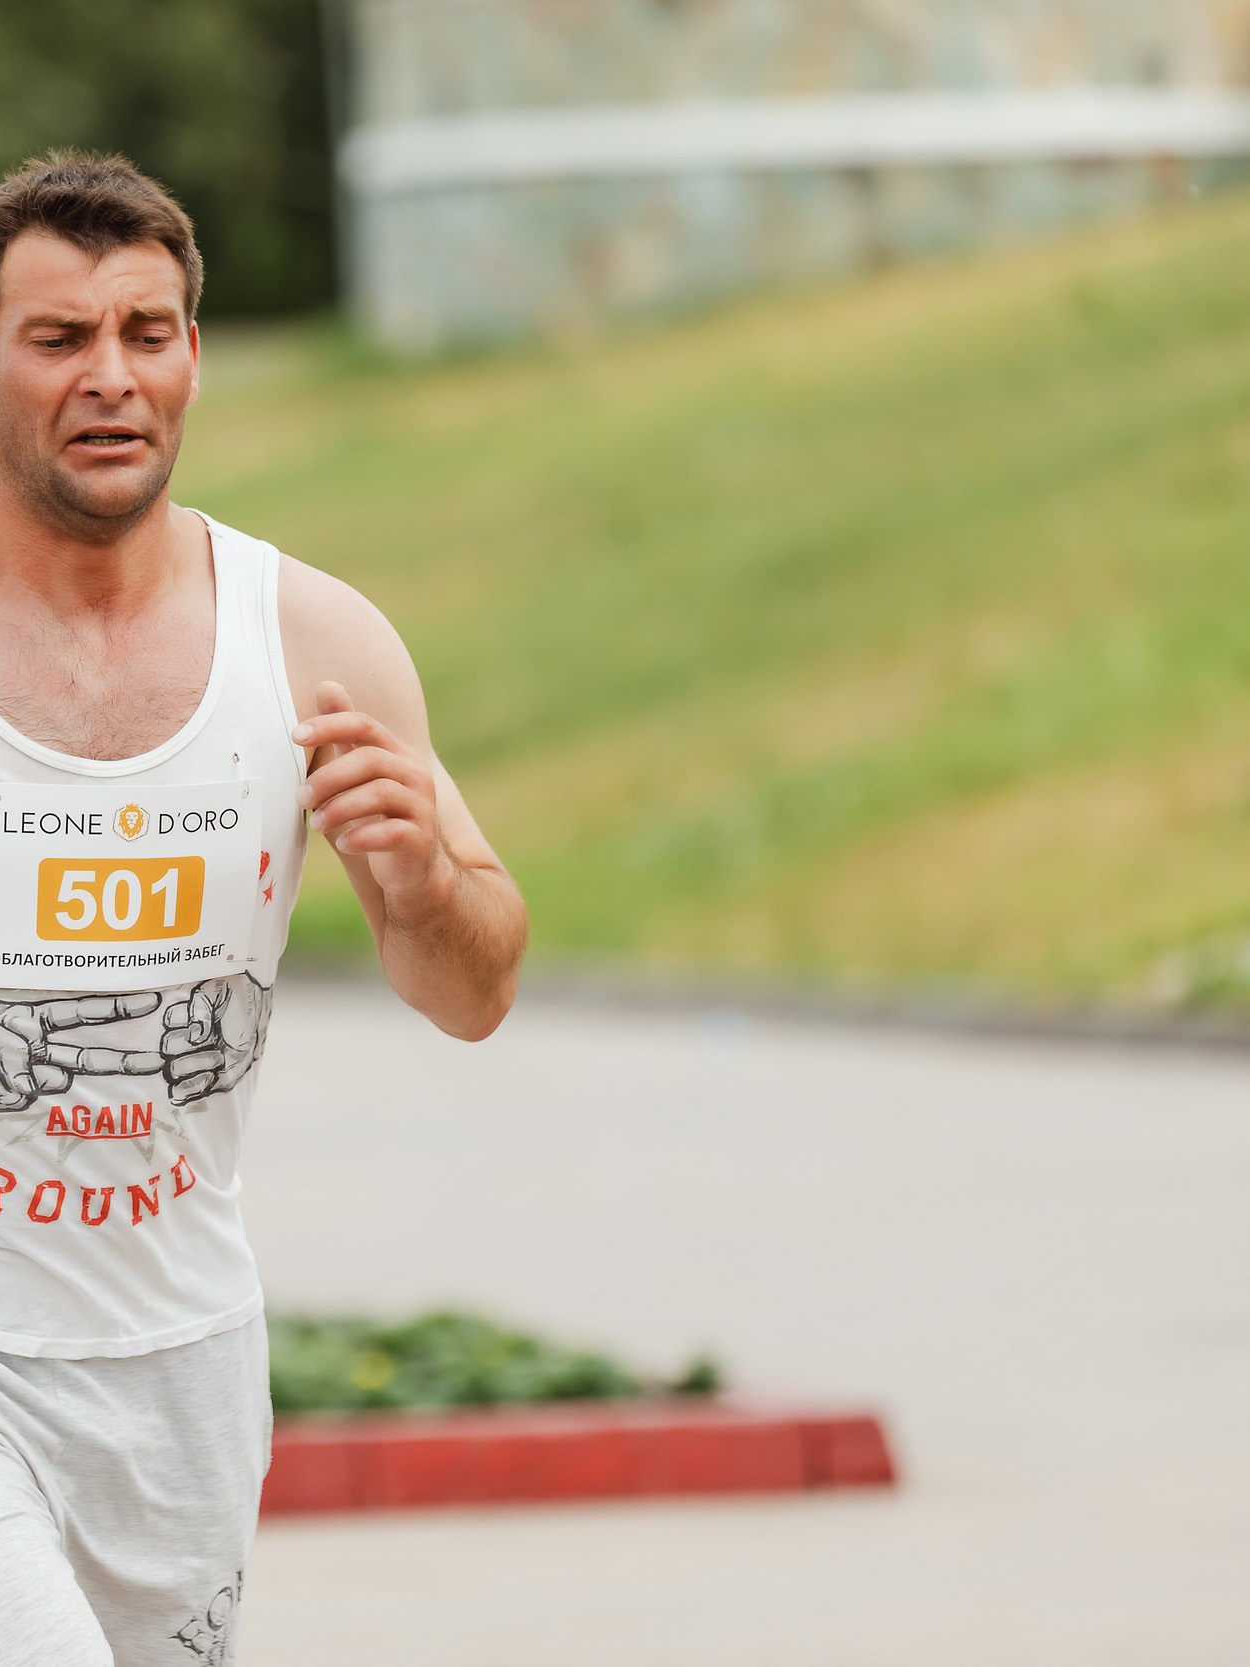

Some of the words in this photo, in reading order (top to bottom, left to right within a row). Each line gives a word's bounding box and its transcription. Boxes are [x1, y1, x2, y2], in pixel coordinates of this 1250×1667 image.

[2, 811, 103, 836] LEONE
[54, 867, 180, 931] 501
[1, 947, 182, 968] БЛАГОТВОРИТЕЛЬНЫЙ
[184, 943, 226, 962] ЗАБЕГ
[46, 1101, 153, 1138] AGAIN
